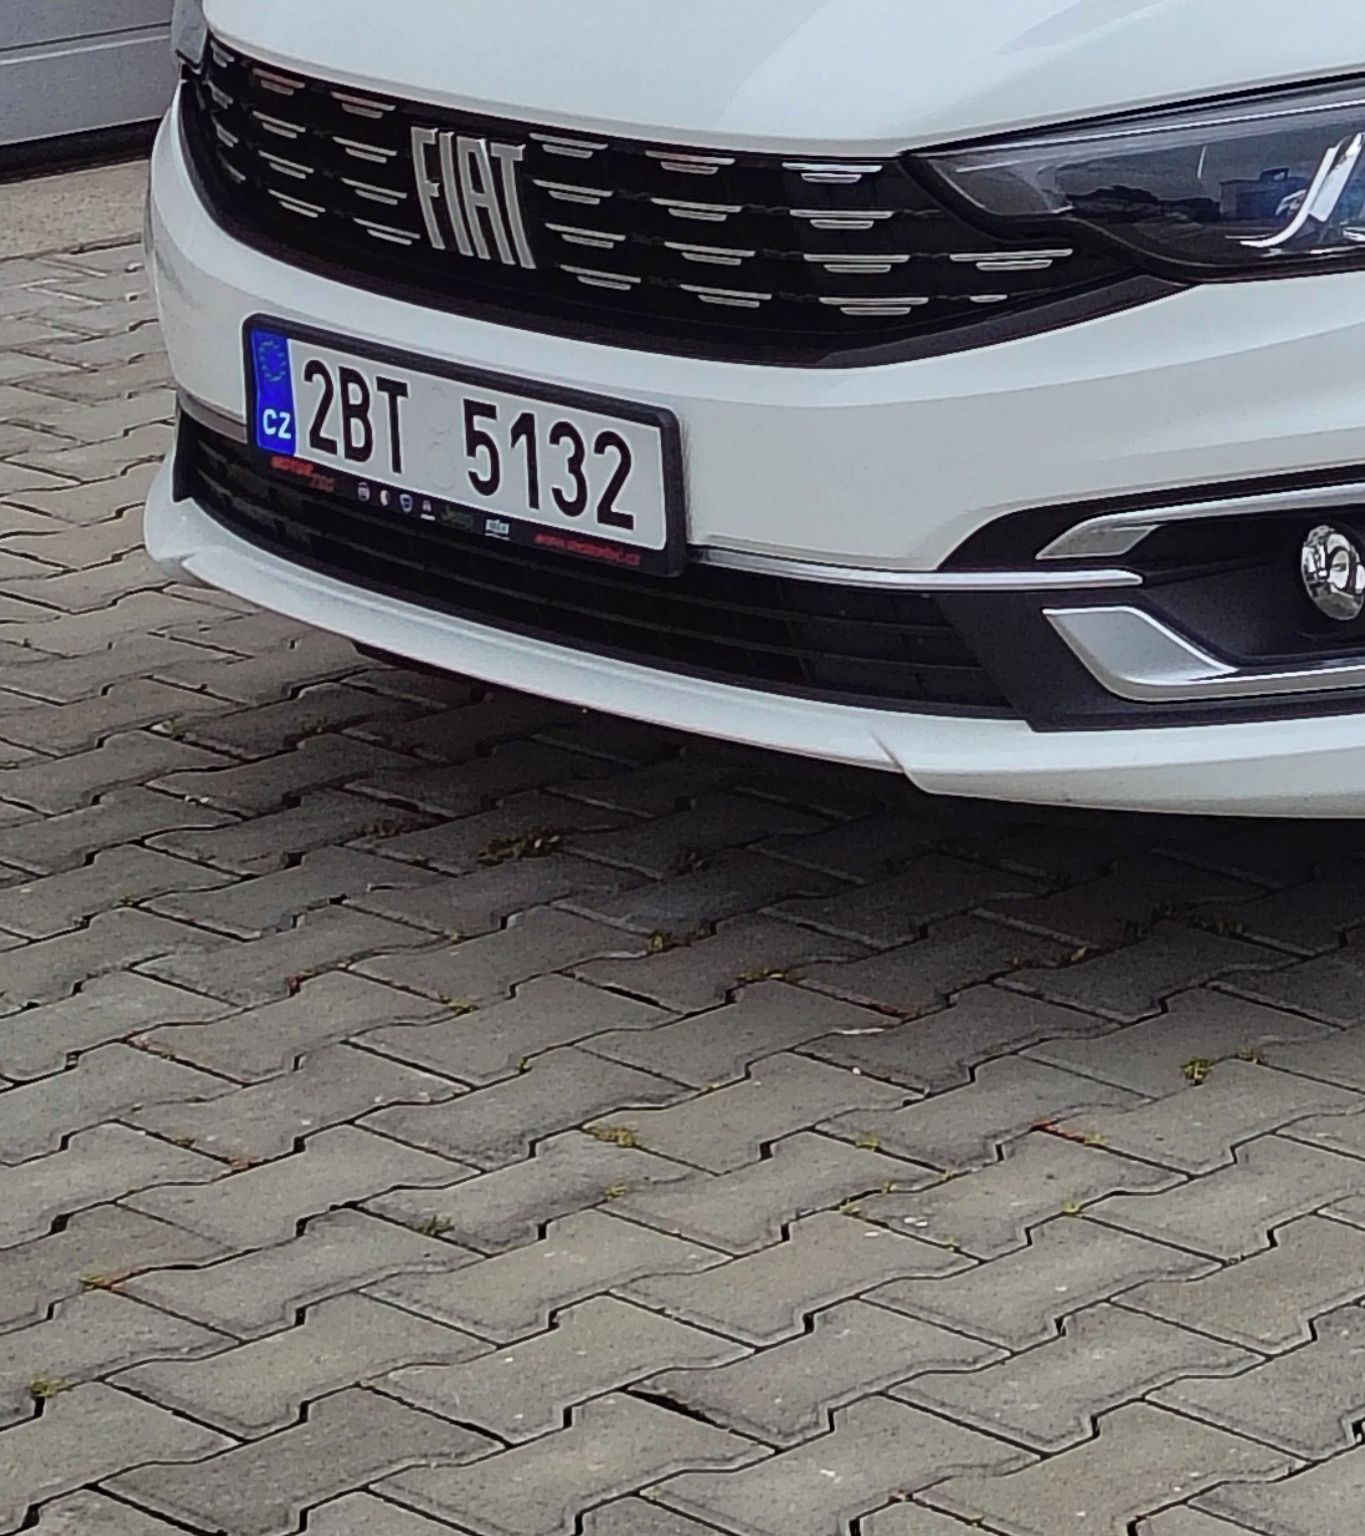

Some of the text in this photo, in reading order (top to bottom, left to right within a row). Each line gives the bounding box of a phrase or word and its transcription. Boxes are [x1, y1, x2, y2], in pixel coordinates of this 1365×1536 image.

[410, 125, 537, 270] FIAT
[262, 409, 292, 441] CZ
[303, 359, 635, 531] 2BT 5132
